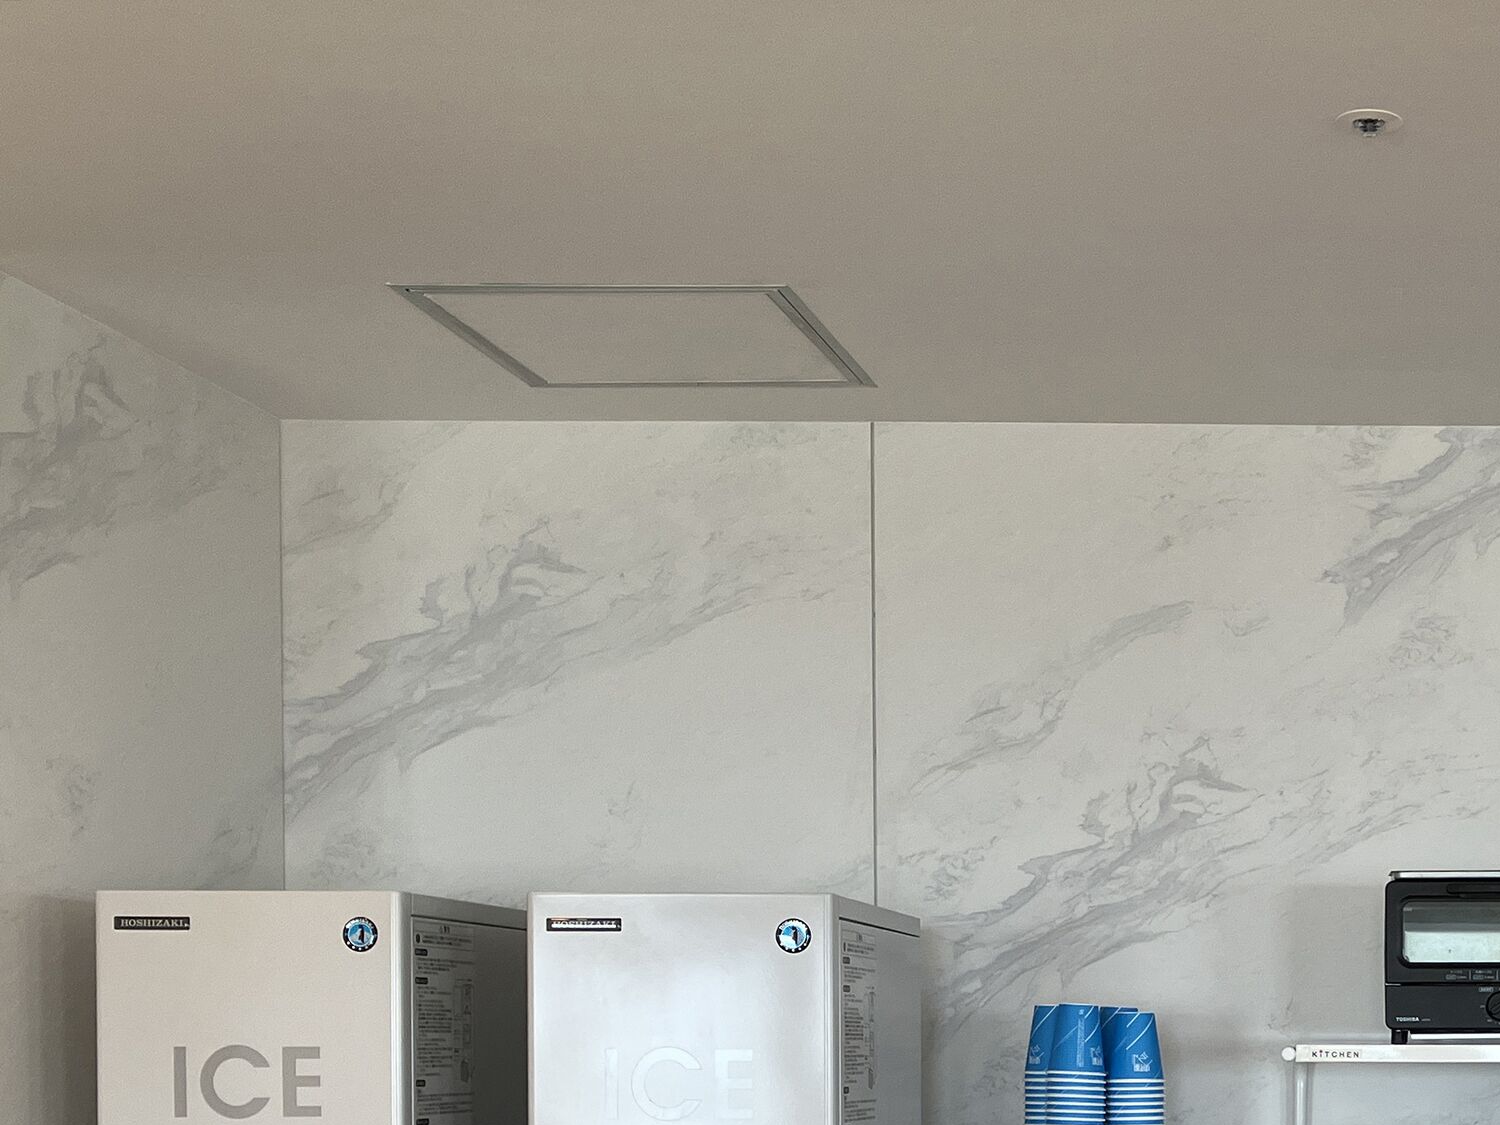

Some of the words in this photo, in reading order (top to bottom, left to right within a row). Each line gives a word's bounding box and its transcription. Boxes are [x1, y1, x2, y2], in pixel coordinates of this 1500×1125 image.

[120, 918, 186, 928] HOSHIZAKI
[173, 1044, 322, 1119] ICE
[603, 1046, 754, 1122] ICE
